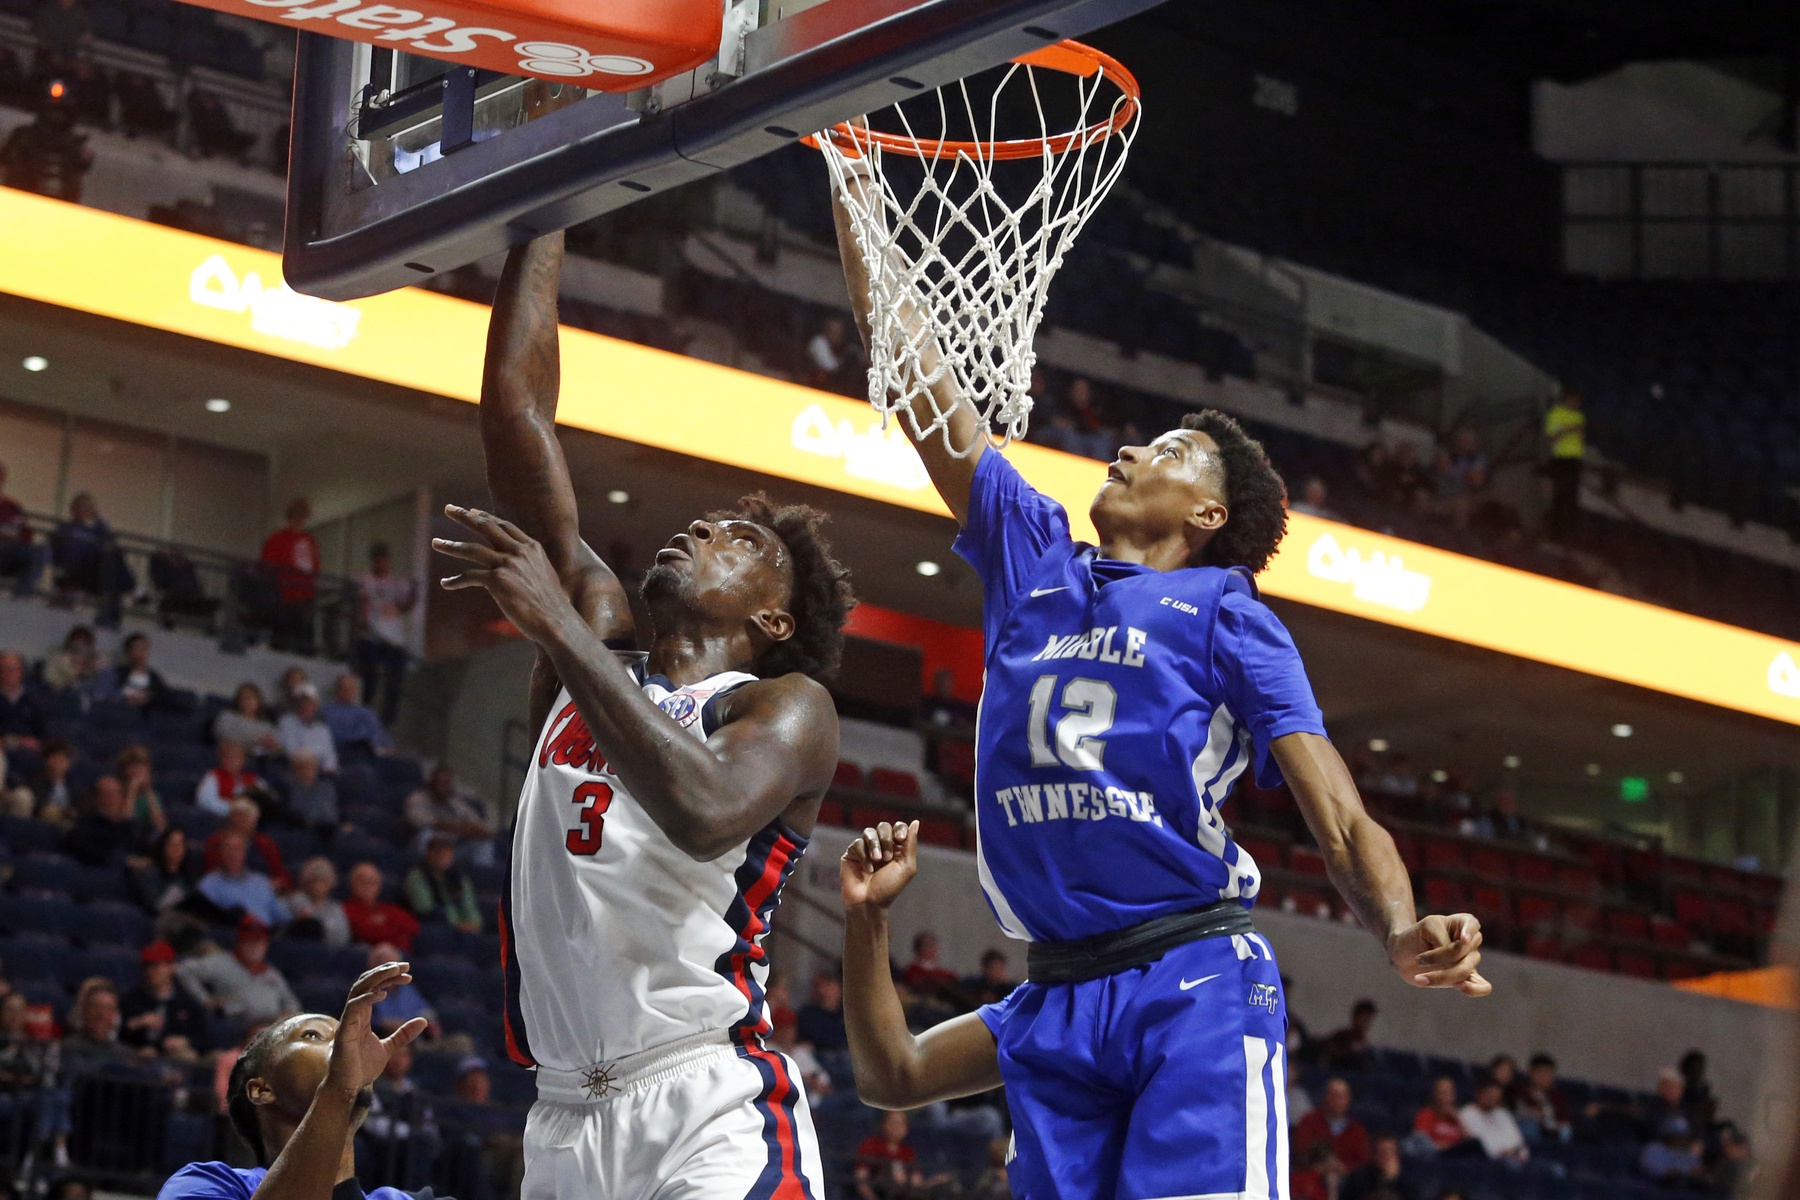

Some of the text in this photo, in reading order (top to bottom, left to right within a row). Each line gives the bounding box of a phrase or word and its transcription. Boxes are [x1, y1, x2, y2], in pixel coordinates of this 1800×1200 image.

[1171, 600, 1199, 616] USA
[1031, 626, 1148, 669] MIDDLE
[1027, 674, 1118, 772] 12
[565, 780, 614, 856] 3
